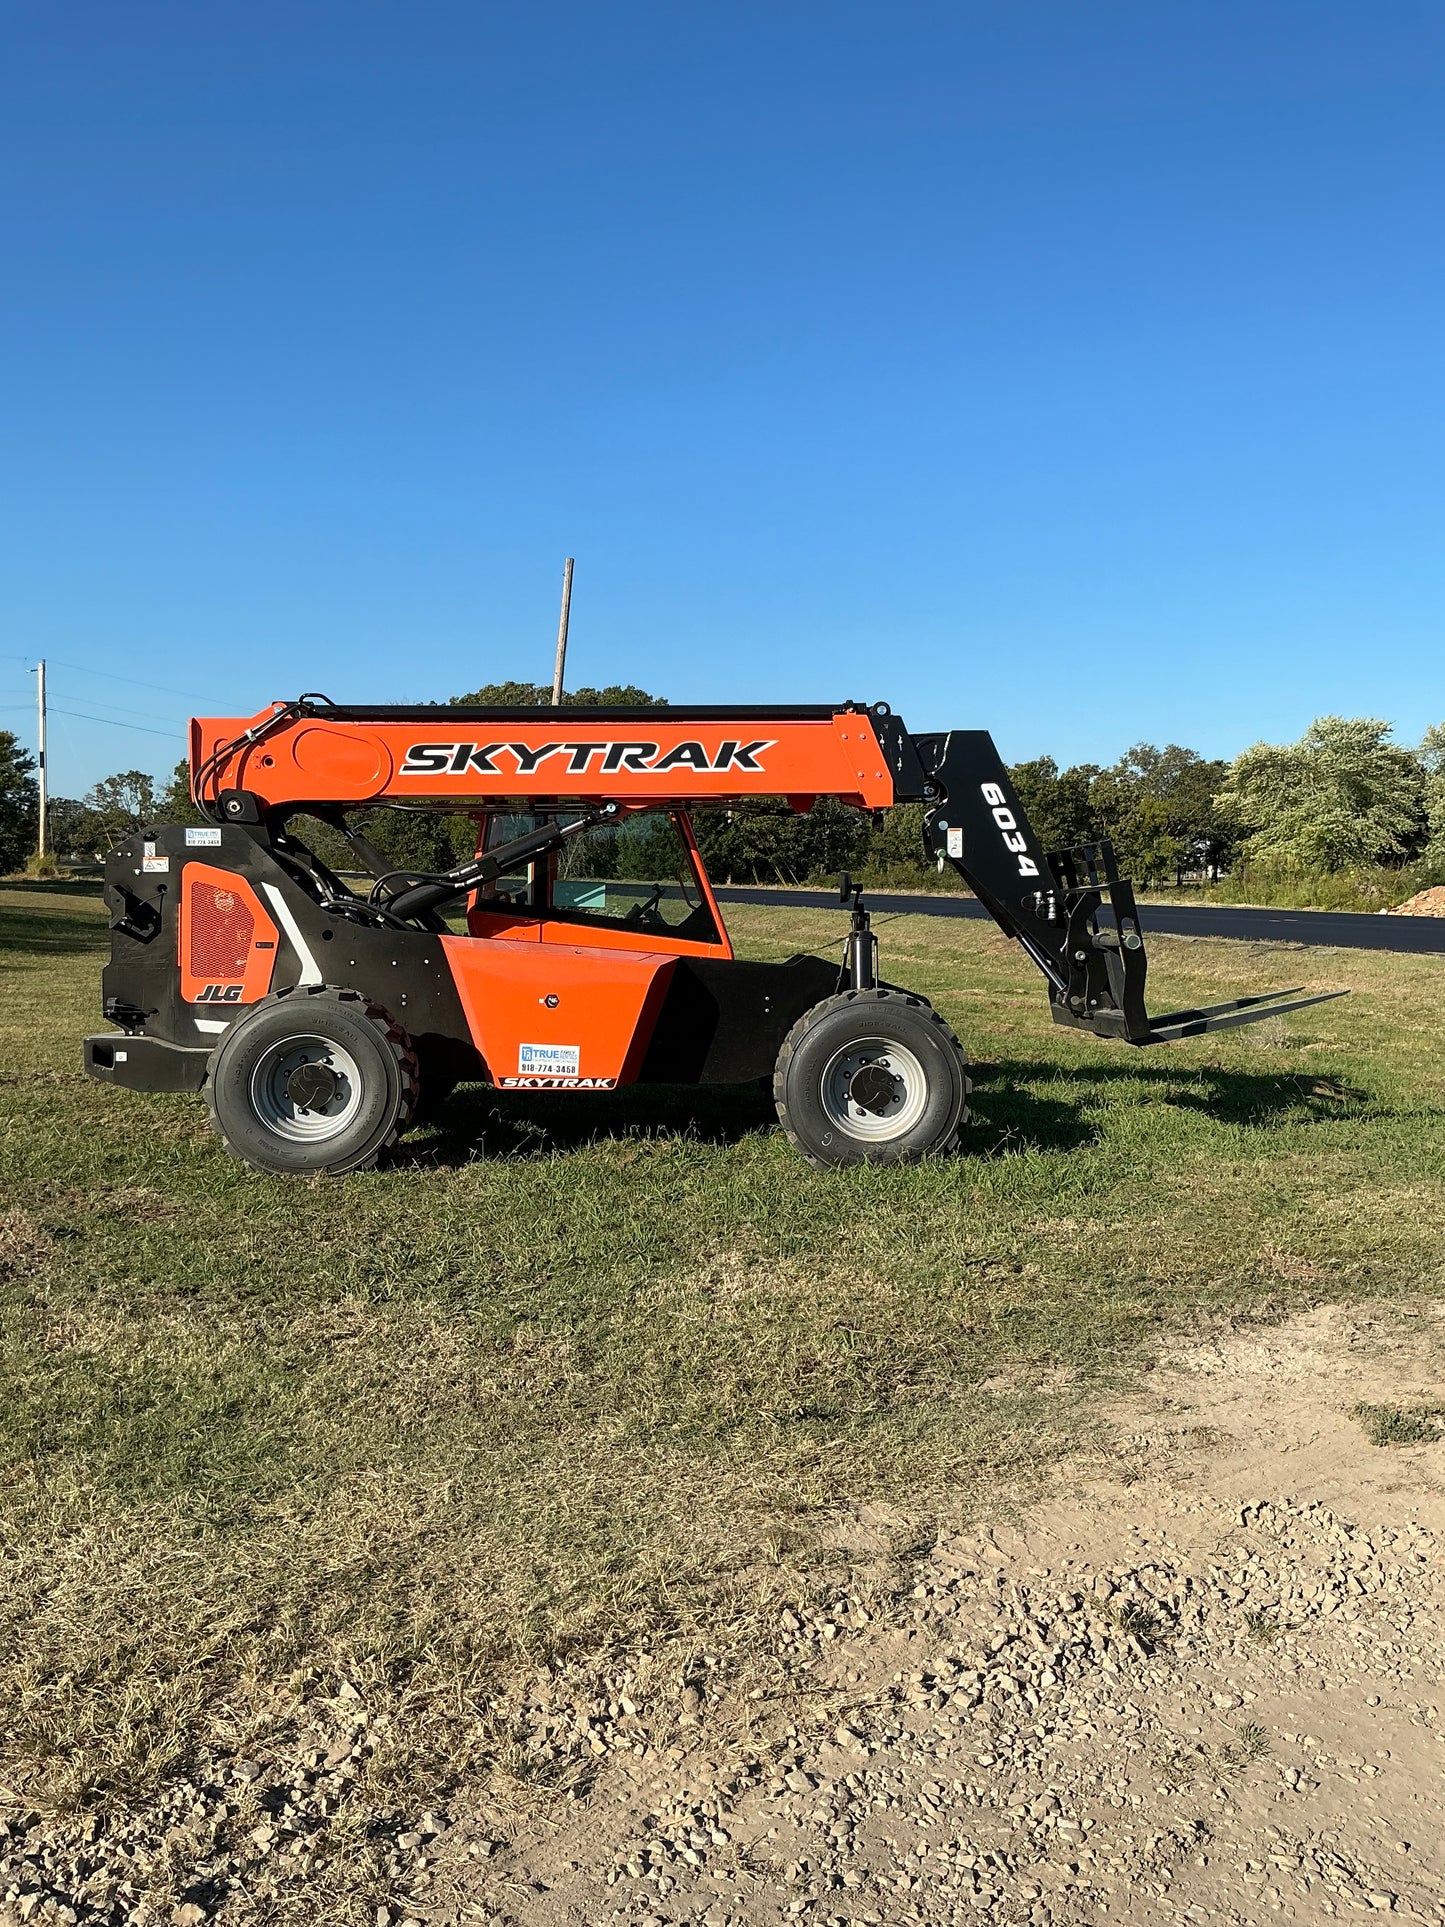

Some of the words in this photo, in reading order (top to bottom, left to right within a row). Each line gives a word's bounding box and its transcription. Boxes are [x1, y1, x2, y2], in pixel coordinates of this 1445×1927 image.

[399, 740, 778, 775] SKYTRAK
[980, 782, 1040, 877] 6034
[195, 984, 245, 1002] JLG
[533, 1049, 560, 1059] TRUE
[521, 1063, 576, 1074] 918-774-3458
[502, 1078, 612, 1088] SKYTRAK
